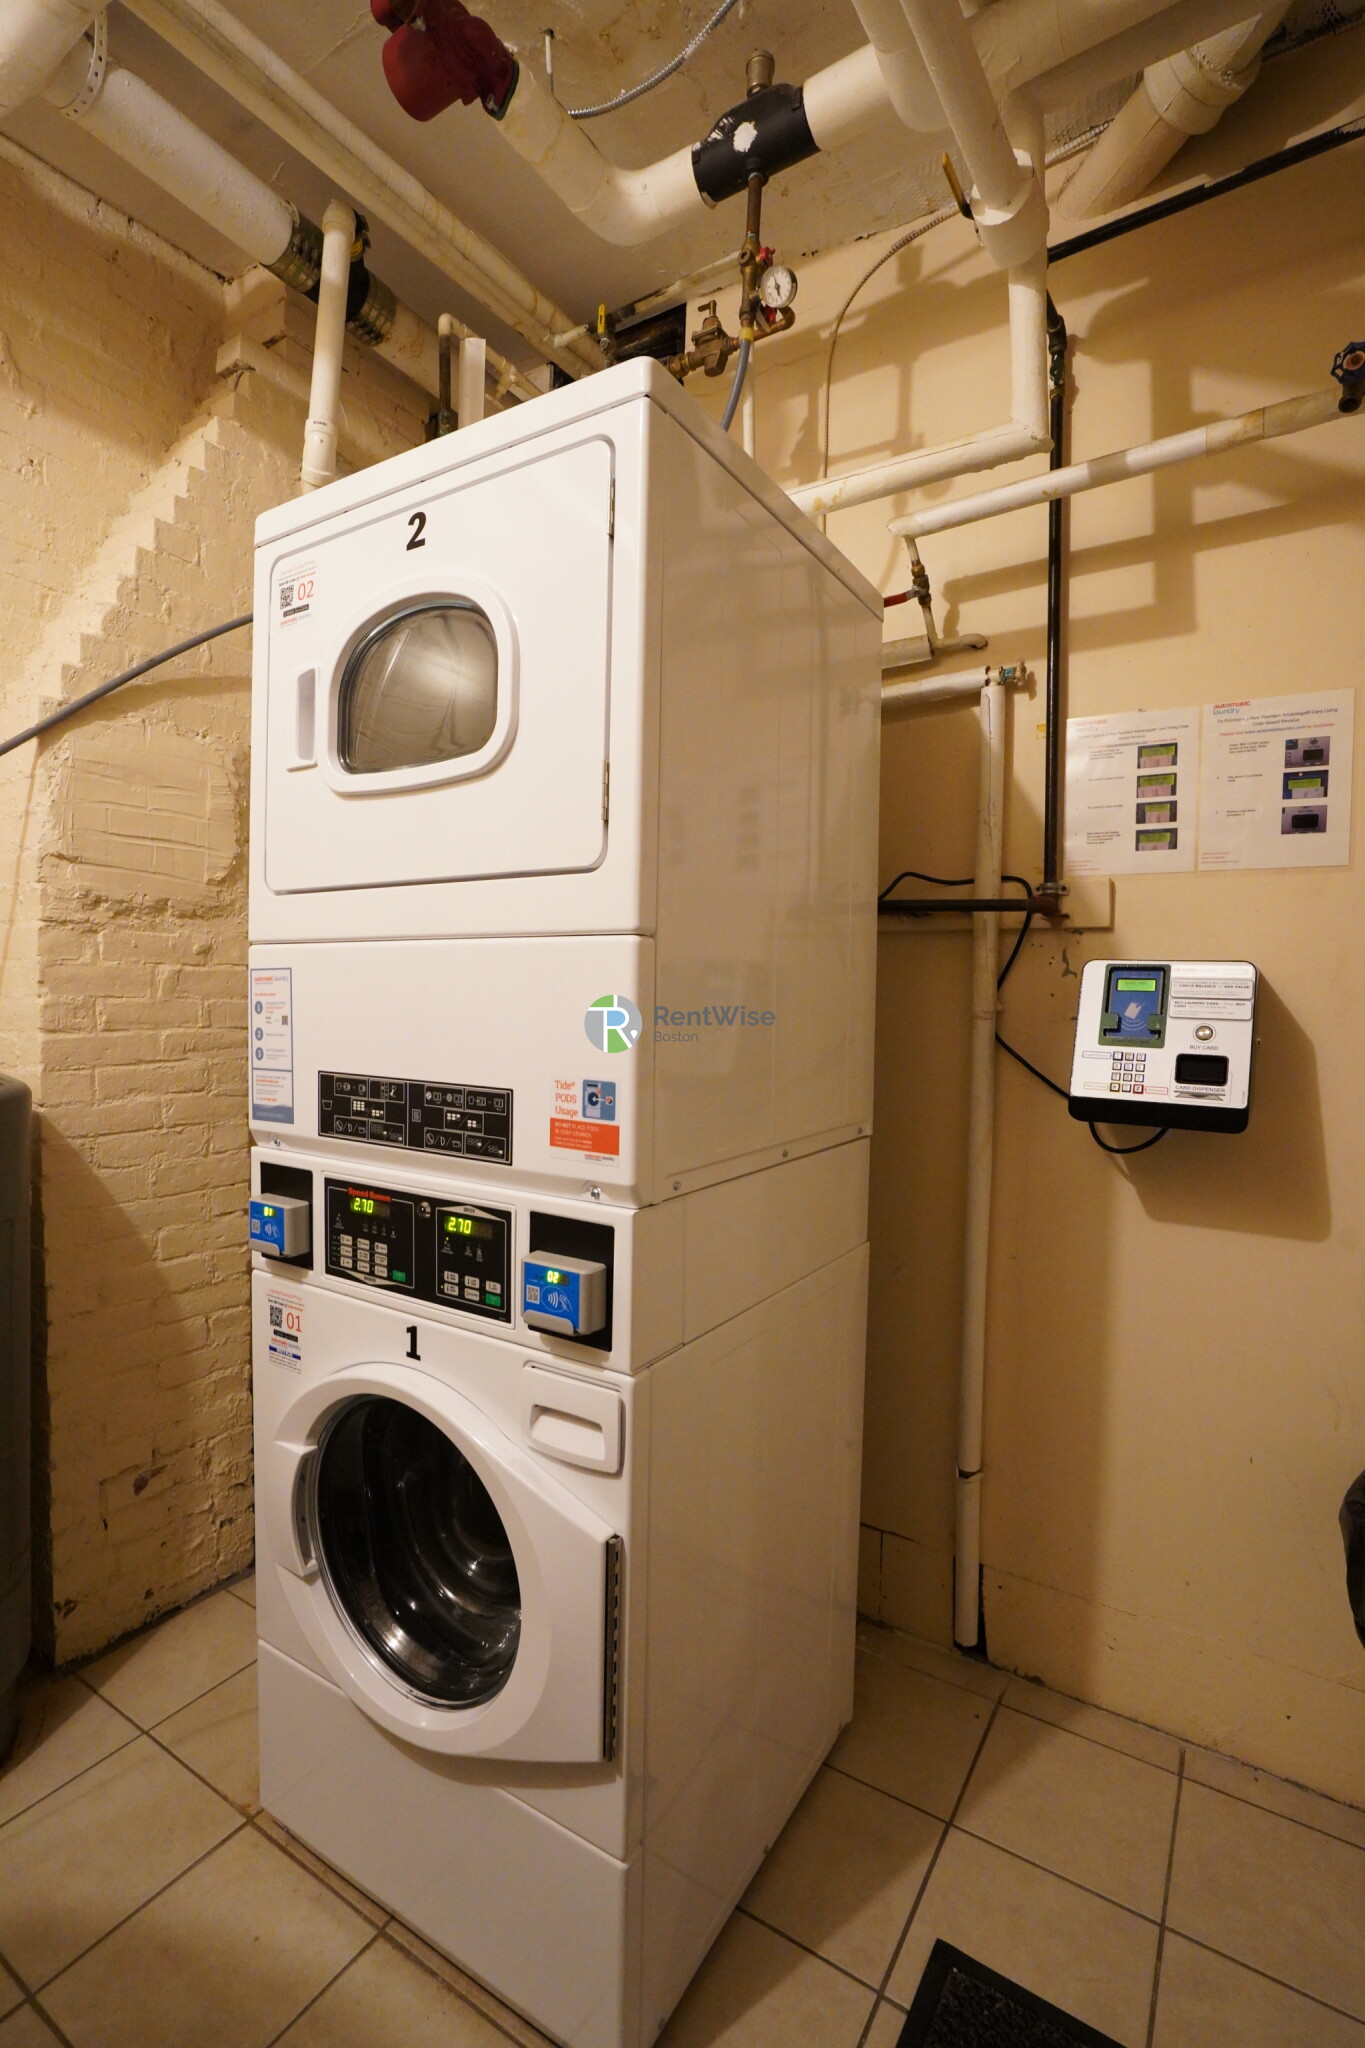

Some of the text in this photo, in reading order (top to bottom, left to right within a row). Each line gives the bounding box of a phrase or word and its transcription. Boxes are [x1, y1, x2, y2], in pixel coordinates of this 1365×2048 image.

[406, 511, 427, 551] 2
[297, 579, 314, 601] 02
[1212, 707, 1240, 716] laundry
[1213, 700, 1251, 710] automatic
[555, 1080, 576, 1090] Tide®
[555, 1093, 577, 1104] PODS
[555, 1106, 579, 1118] Usage
[347, 1186, 392, 1203] Speed Queen
[353, 1197, 374, 1214] 2.70
[448, 1216, 472, 1234] 2.70
[547, 1270, 559, 1284] 02
[286, 1311, 303, 1333] 01
[406, 1325, 421, 1362] 1
